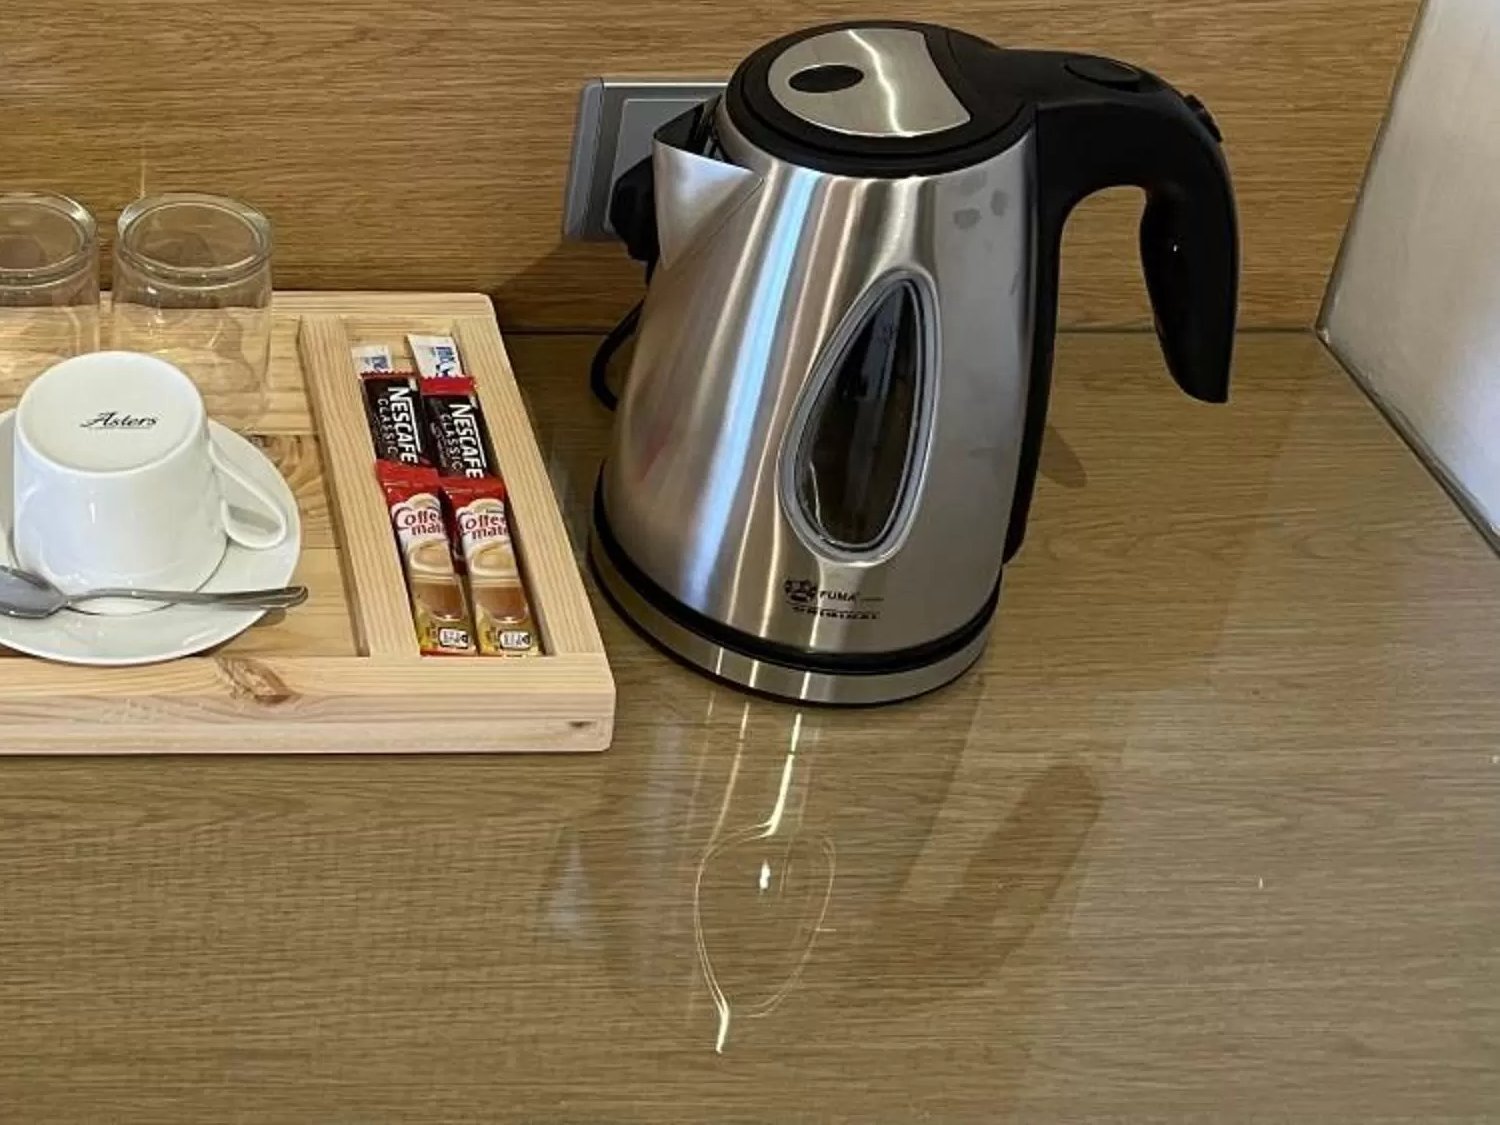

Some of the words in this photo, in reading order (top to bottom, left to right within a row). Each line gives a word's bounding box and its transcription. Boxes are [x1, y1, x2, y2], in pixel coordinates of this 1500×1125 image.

[79, 411, 159, 427] Asters
[378, 398, 399, 455] CLASSIC
[440, 413, 464, 473] CLASSIC
